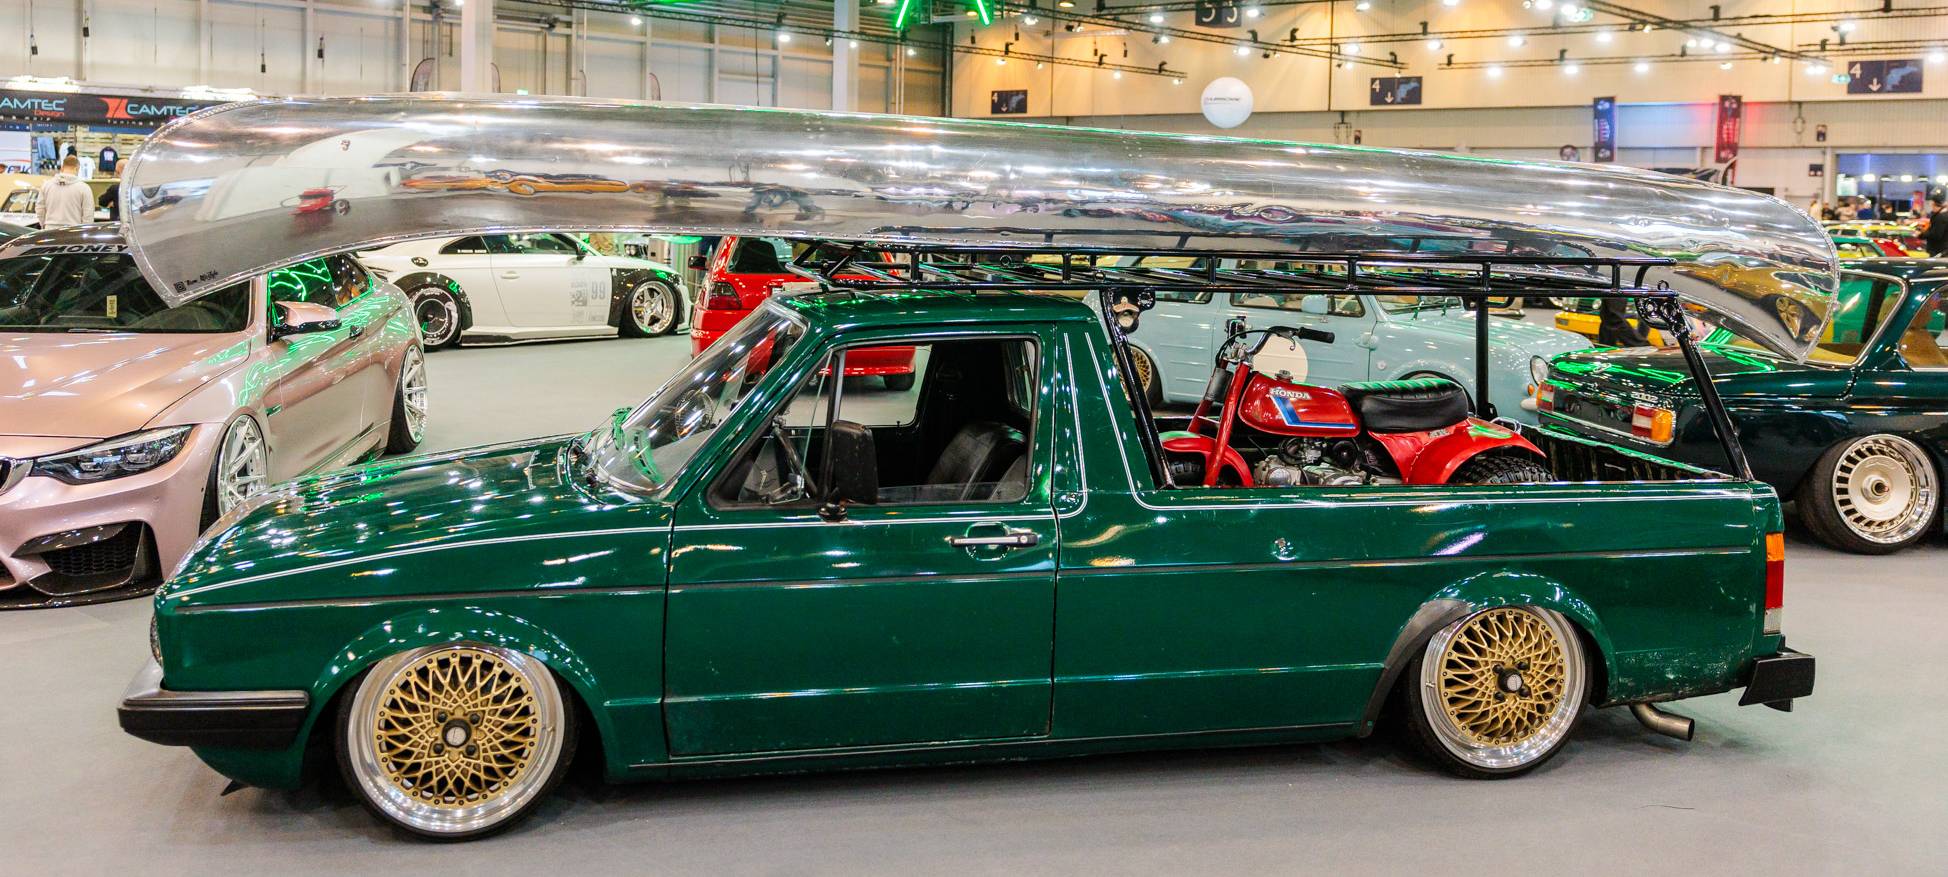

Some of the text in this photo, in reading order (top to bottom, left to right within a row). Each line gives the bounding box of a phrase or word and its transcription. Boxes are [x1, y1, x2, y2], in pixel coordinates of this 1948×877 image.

[1849, 62, 1862, 79] 4
[1371, 79, 1380, 93] 4
[41, 245, 128, 254] MONEY
[591, 281, 606, 300] 99
[1269, 386, 1313, 400] HONDA
[1631, 391, 1659, 403] 2002
